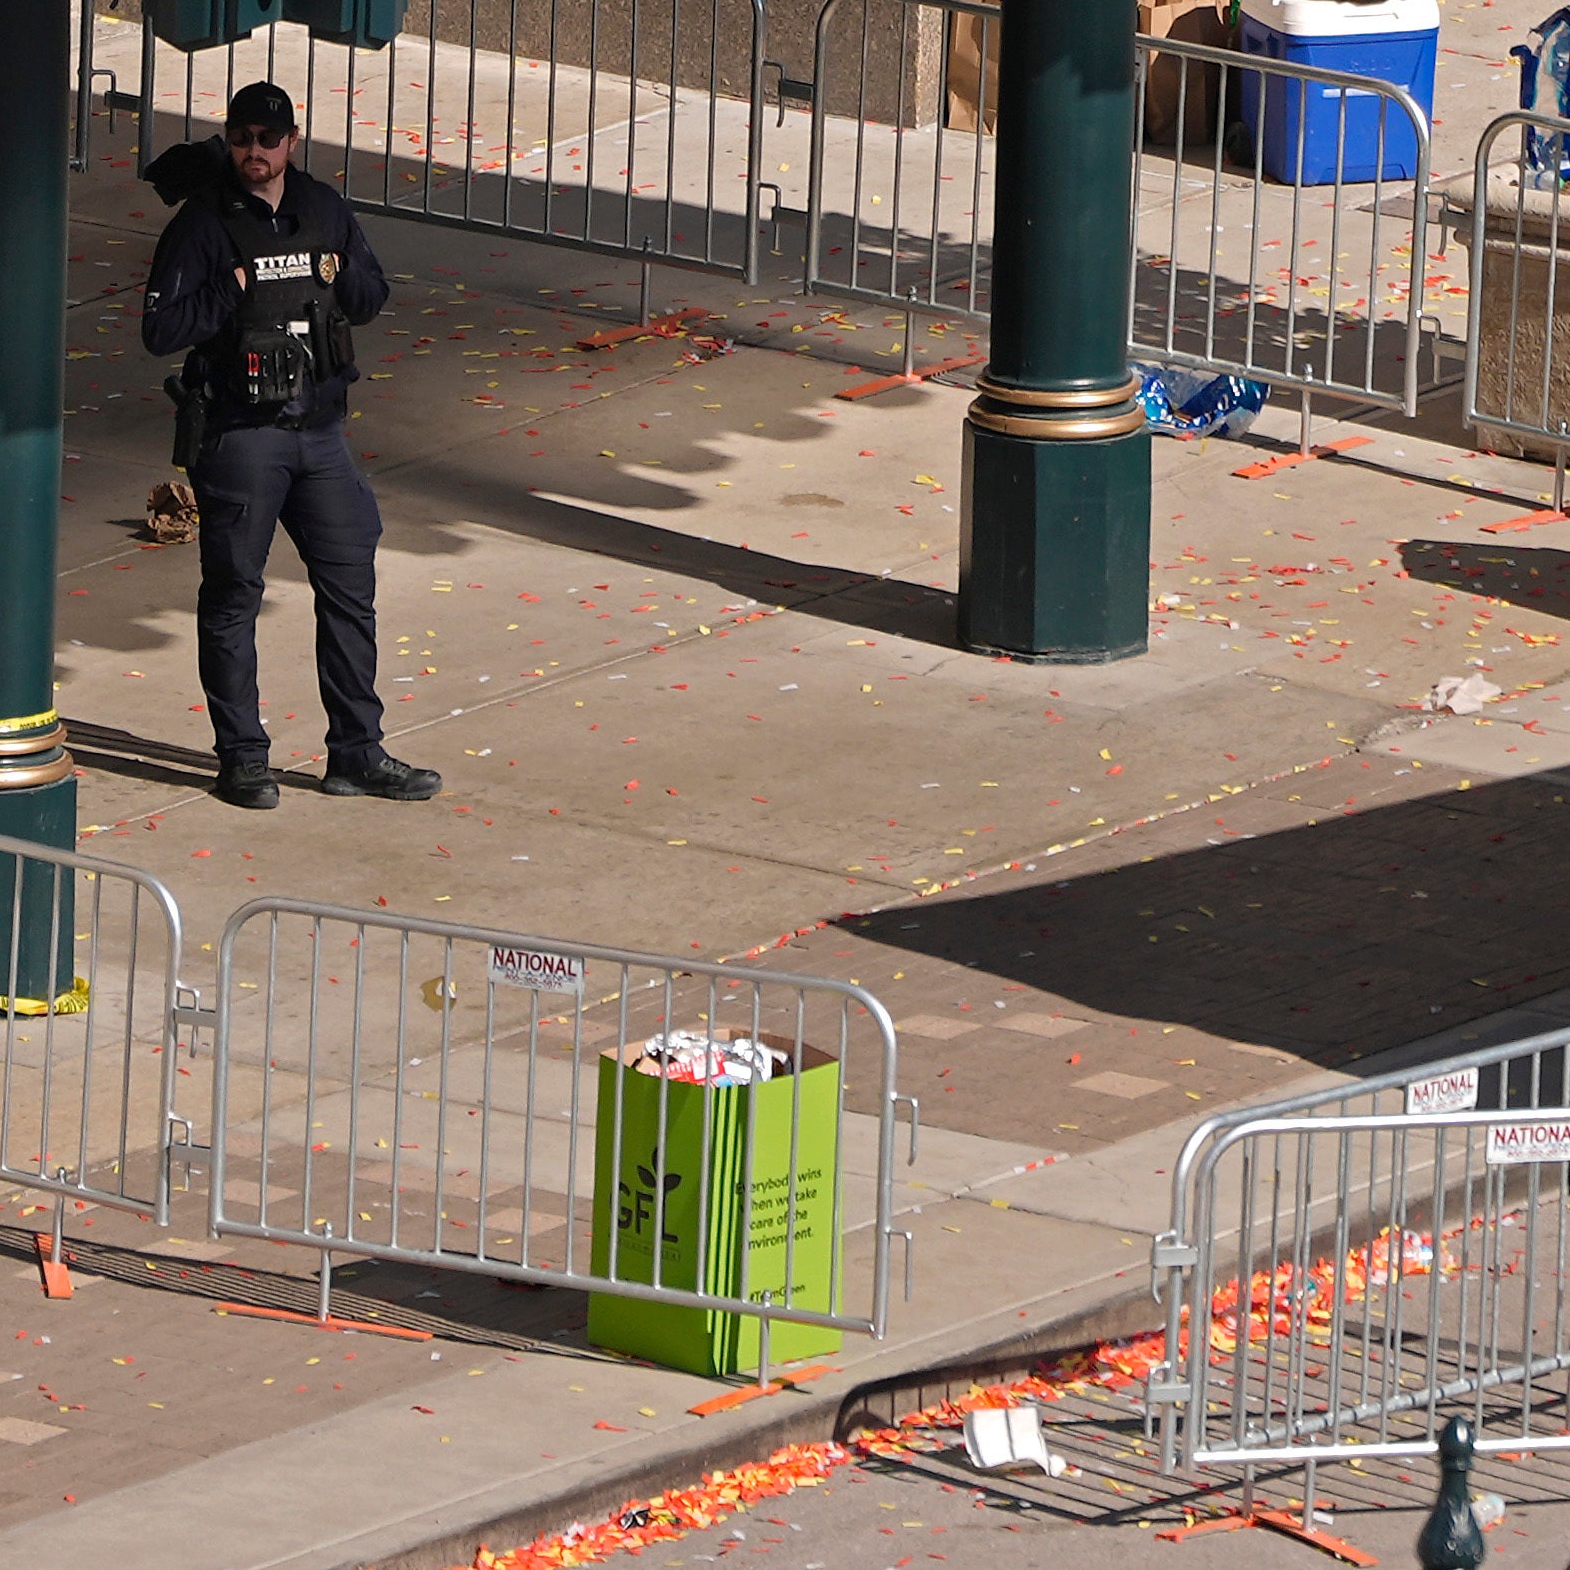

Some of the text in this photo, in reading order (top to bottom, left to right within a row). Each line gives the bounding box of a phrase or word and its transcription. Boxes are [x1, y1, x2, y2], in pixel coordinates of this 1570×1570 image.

[253, 252, 311, 270] TITAN
[492, 946, 577, 978] NATIONAL
[1413, 1073, 1474, 1100] NATIONAL
[735, 1168, 823, 1196] Eerybod wins
[609, 1178, 680, 1244] GFL
[740, 1198, 773, 1214] hen
[795, 1187, 818, 1202] take
[747, 1226, 815, 1250] nvironent.
[749, 1219, 774, 1231] care
